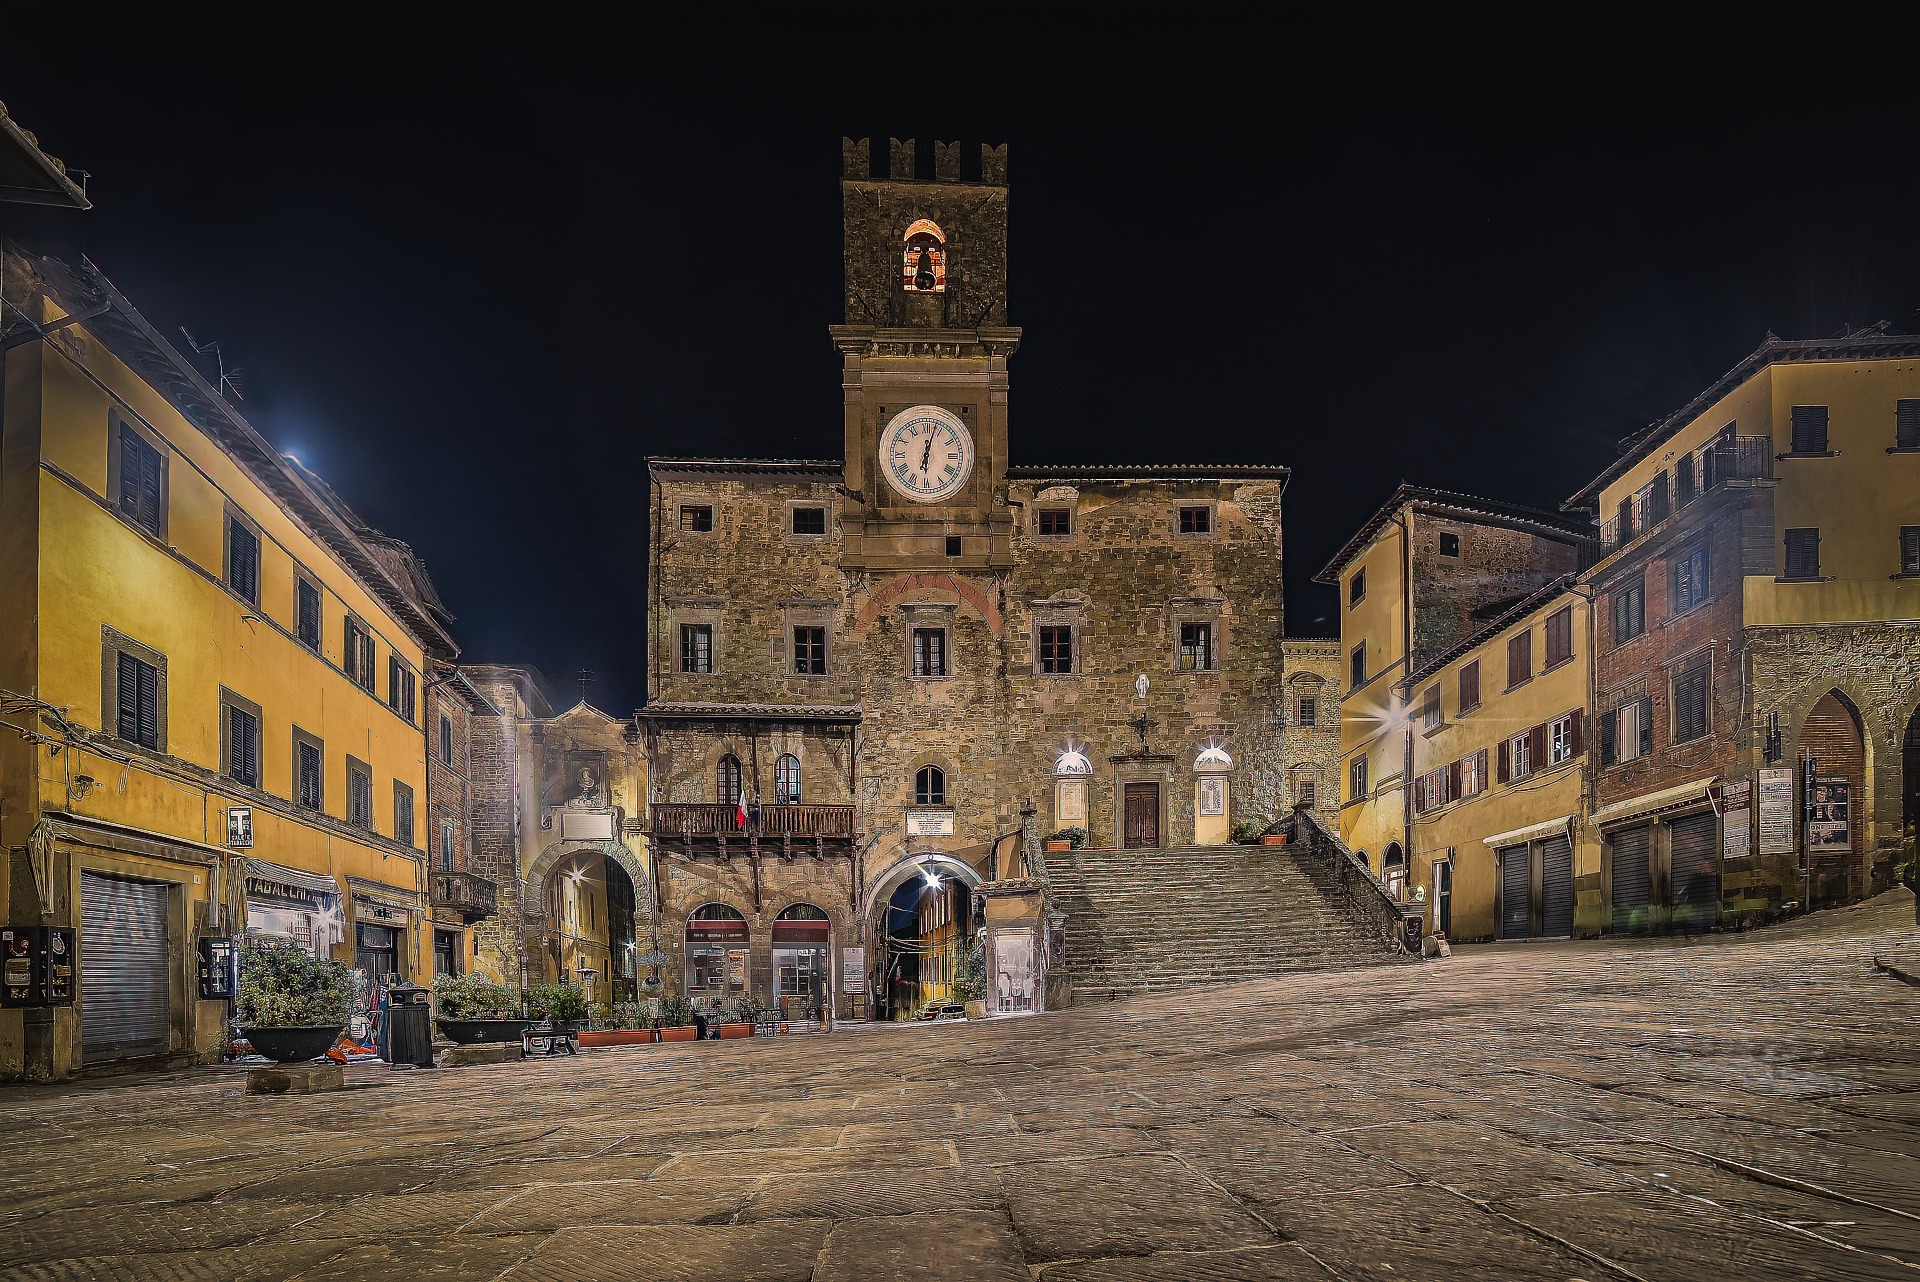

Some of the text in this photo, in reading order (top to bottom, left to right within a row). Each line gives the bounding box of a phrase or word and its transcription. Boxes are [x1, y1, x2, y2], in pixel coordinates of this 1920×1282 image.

[908, 426, 918, 438] XI
[922, 423, 931, 434] XII
[898, 437, 909, 446] X
[944, 438, 954, 446] II
[895, 451, 905, 459] IX
[923, 478, 930, 488] VI
[937, 476, 944, 485] V
[231, 811, 249, 835] T
[249, 877, 306, 900] TABACCHI
